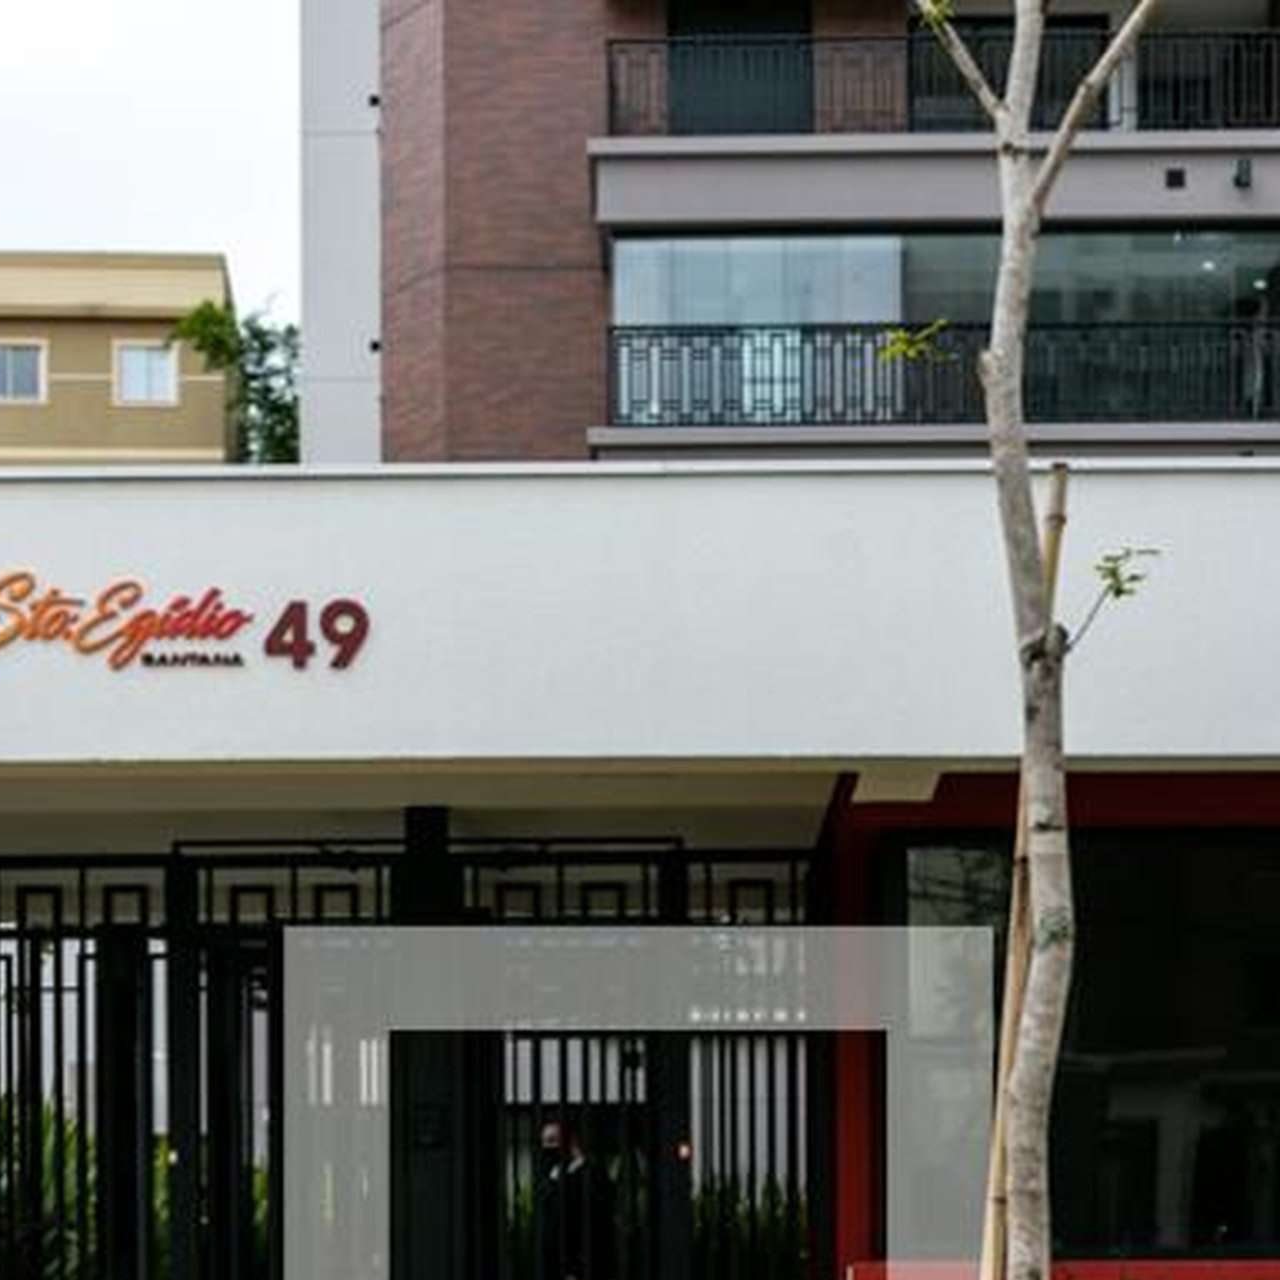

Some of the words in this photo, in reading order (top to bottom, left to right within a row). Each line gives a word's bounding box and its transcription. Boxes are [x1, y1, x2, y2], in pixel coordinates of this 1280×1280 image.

[75, 580, 253, 671] Egídio
[264, 600, 370, 670] 49
[141, 652, 244, 668] SANTANA
